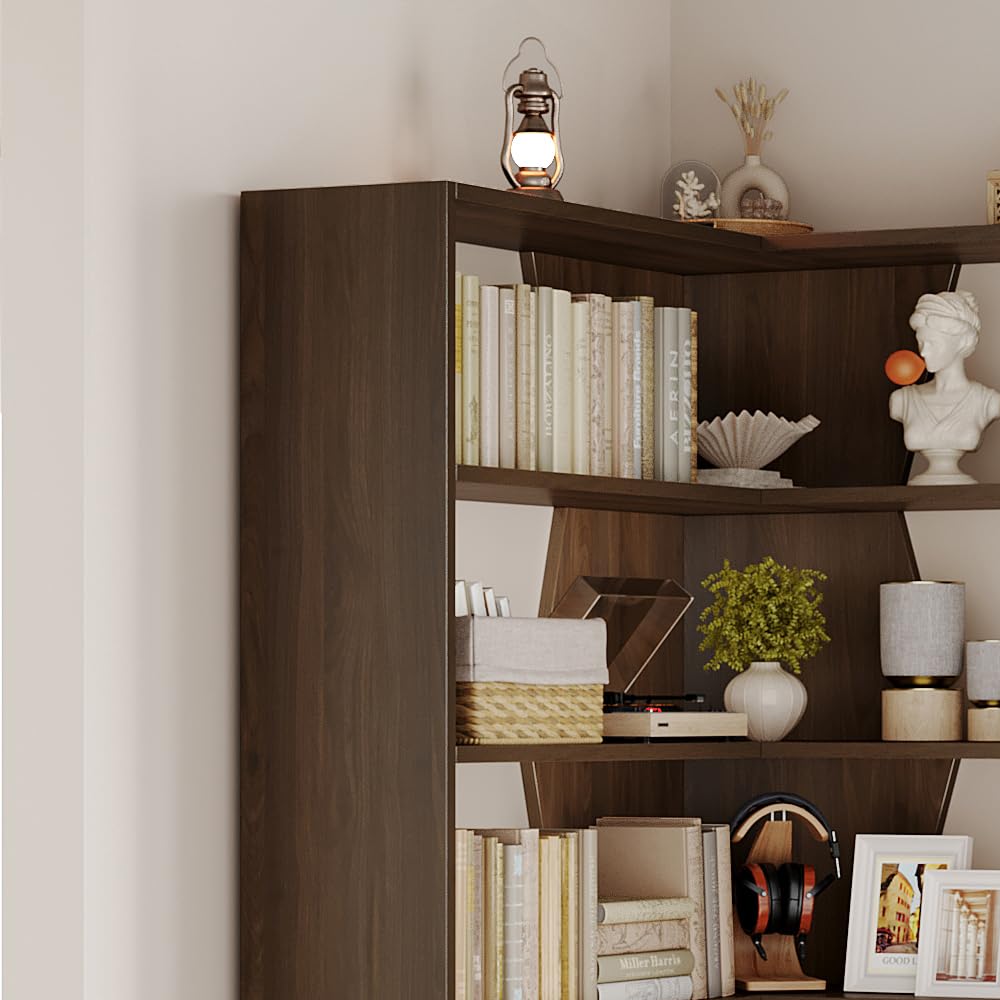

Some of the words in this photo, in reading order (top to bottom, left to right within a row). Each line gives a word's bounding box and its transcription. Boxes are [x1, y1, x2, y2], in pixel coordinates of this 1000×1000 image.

[619, 957, 649, 969] Miller
[650, 954, 680, 967] Harris
[882, 956, 911, 965] GOOD
